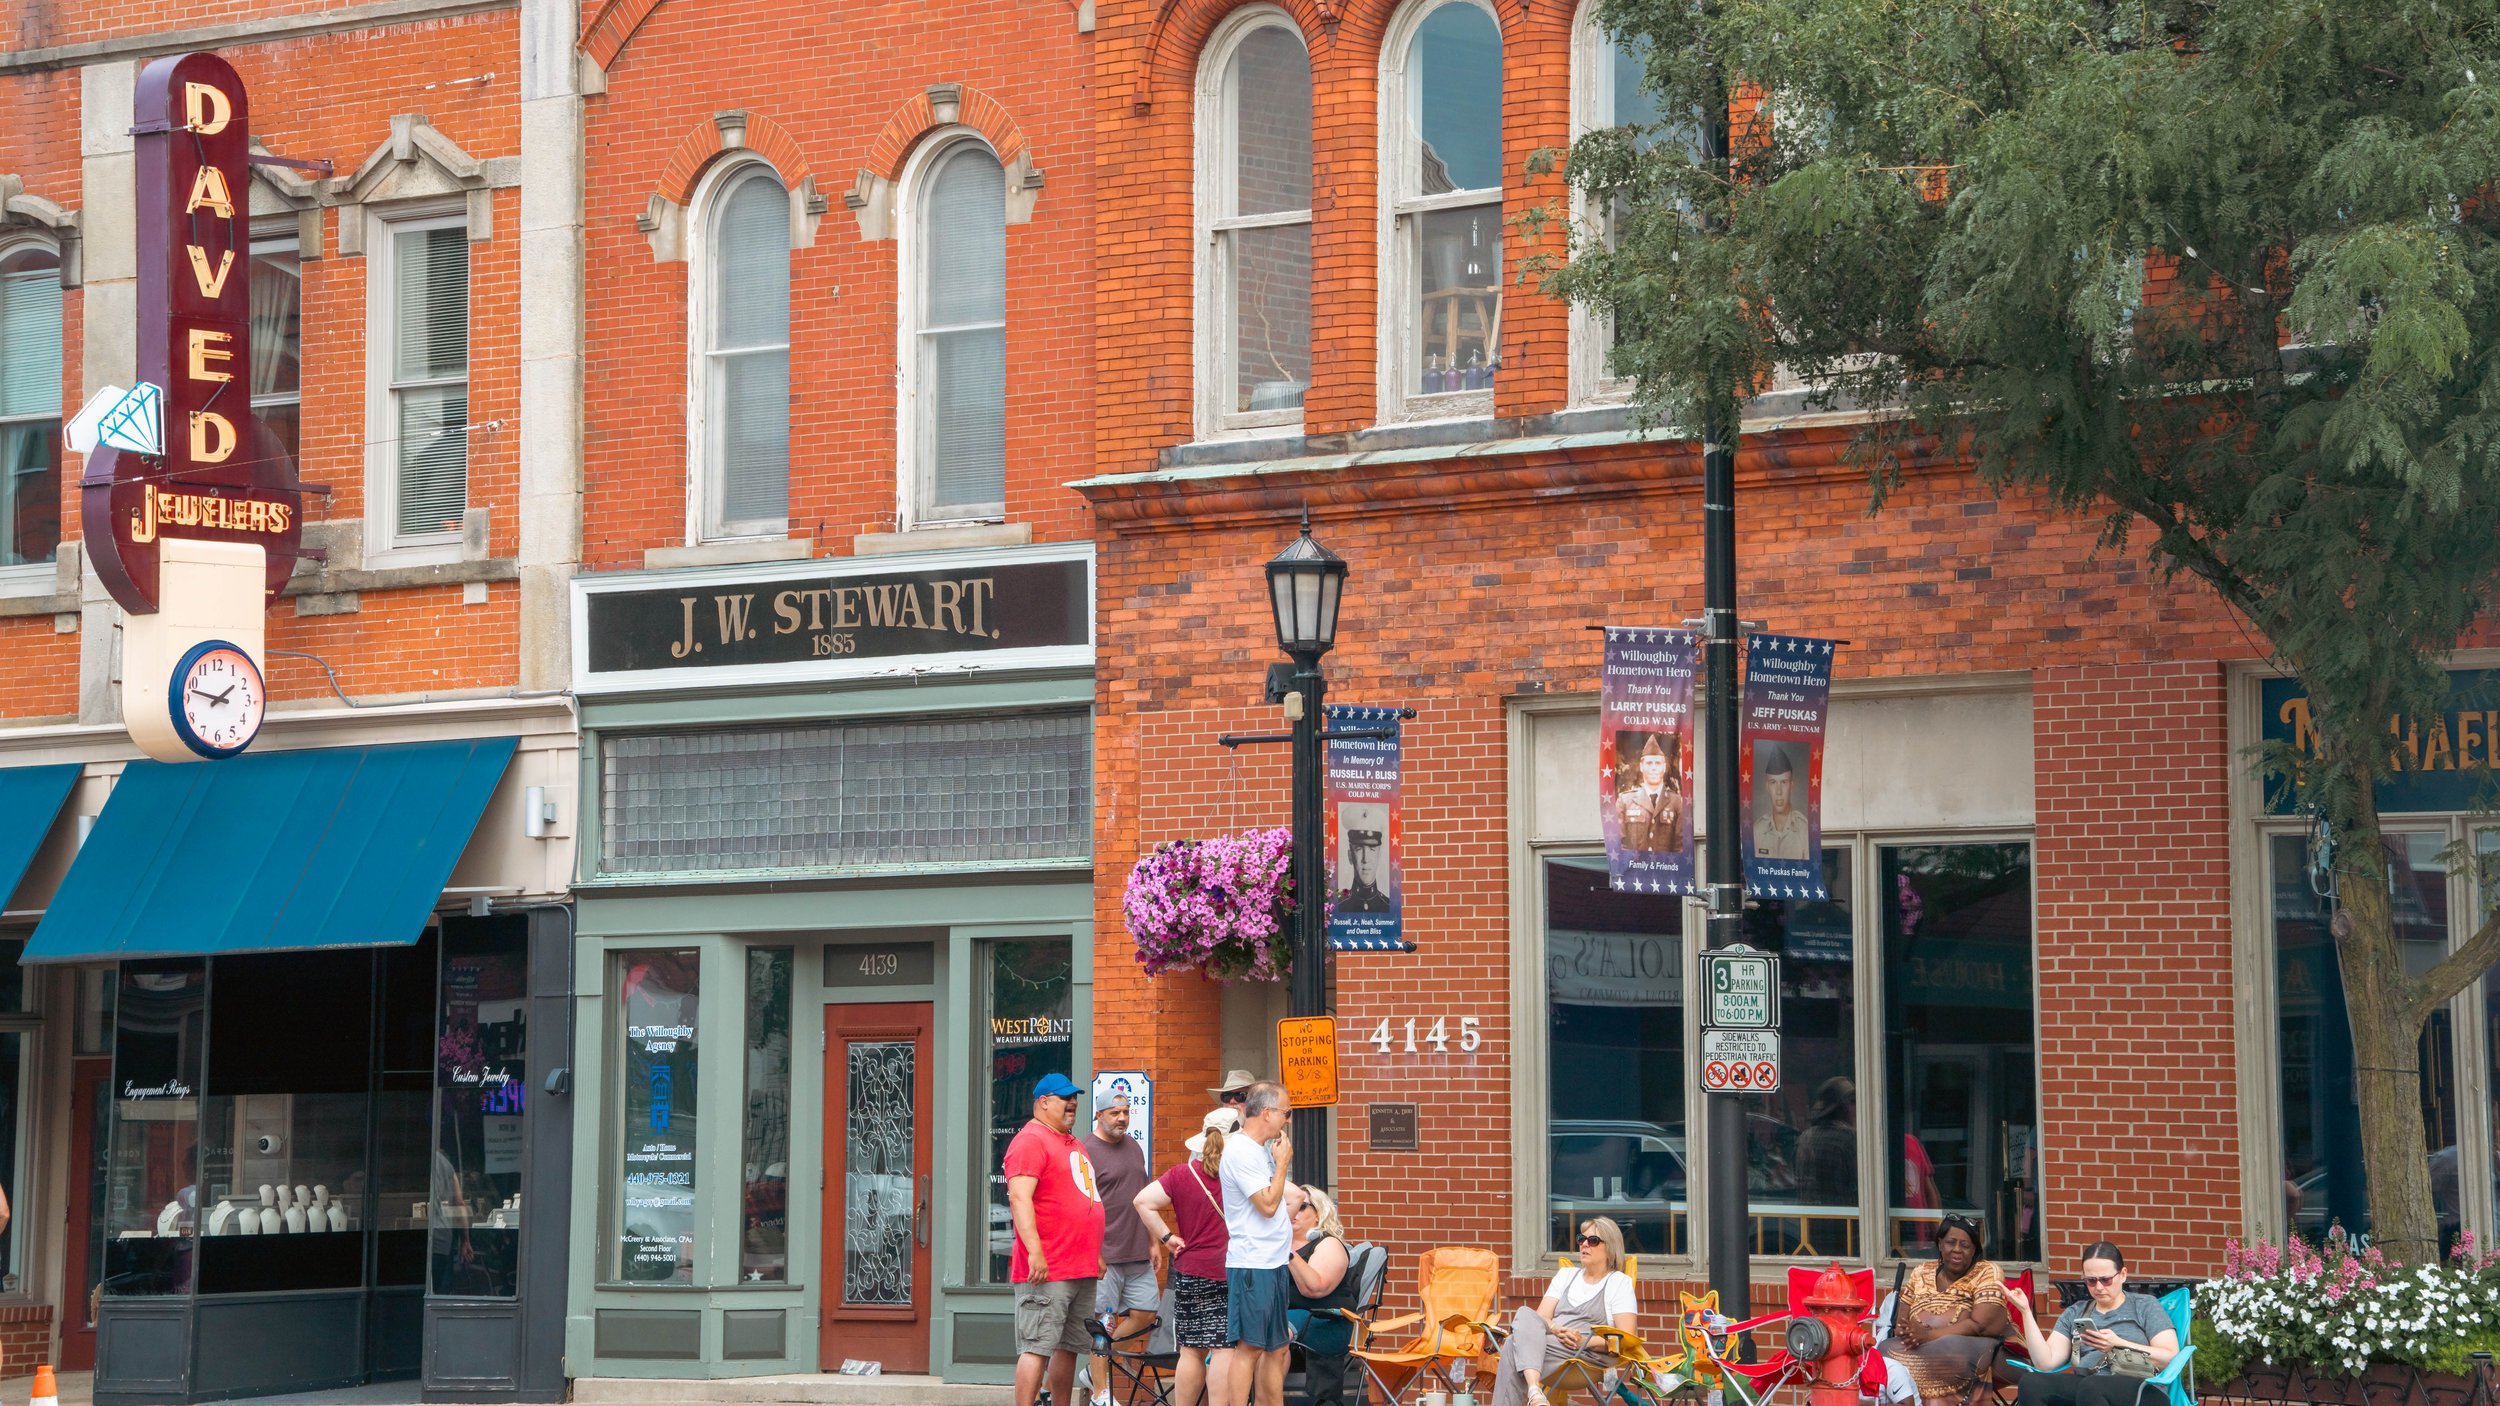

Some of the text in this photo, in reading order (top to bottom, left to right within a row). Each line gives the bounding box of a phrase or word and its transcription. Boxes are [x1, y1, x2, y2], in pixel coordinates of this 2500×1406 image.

[185, 81, 238, 463] DAVED
[131, 484, 292, 543] JEWELERS
[671, 597, 703, 659] J.
[714, 594, 757, 645] W.
[811, 632, 856, 657] 1885
[1620, 650, 1679, 665] Willoughby
[198, 663, 208, 676] 11
[212, 658, 224, 672] 12
[230, 663, 236, 677] 1
[1607, 664, 1692, 678] Hometown Hero
[1762, 657, 1817, 674] Willoughby
[241, 677, 247, 691] 2
[1749, 671, 1827, 687] Hometown Hero
[1628, 683, 1672, 695] Thank You
[244, 694, 252, 707] 3
[1767, 690, 1805, 702] Thank You
[1610, 701, 1687, 714] LARRY PUSKAS
[1752, 706, 1818, 721] JEFF PUSKAS
[239, 712, 246, 725] 4
[1623, 715, 1676, 727] COLD WAR
[200, 725, 207, 738] 7
[229, 725, 236, 739] 5
[1747, 721, 1761, 730] U.S.
[1761, 723, 1782, 731] ARMY
[1788, 724, 1820, 733] VIETNAM
[214, 729, 221, 743] 6
[1329, 738, 1397, 752] Hometown Hero
[1350, 755, 1376, 767] Memory
[1376, 756, 1385, 766] Of
[1329, 768, 1398, 781] RUSSELL P. BLISS
[1335, 781, 1347, 789] U.S.
[1347, 782, 1371, 790] MARINE
[1347, 790, 1380, 799] COLD WAR
[1628, 860, 1679, 871] Family & Friends
[1757, 866, 1811, 879] The Puskas Family
[1346, 927, 1382, 935] and Owen Bliss
[859, 953, 898, 976] 4139
[1741, 964, 1755, 976] HR
[1716, 967, 1729, 991] 3
[1731, 979, 1764, 991] PARKING
[1716, 1008, 1725, 1018] TO
[1725, 1008, 1746, 1020] 6:00
[628, 1024, 694, 1039] The Willoughby
[1369, 1015, 1481, 1053] 4145
[1721, 1032, 1760, 1042] SIDEWALKS
[996, 1034, 1070, 1044] WEALTH MANAGEMENT
[1282, 1034, 1332, 1048] STOPPING
[644, 1040, 677, 1054] Agency
[1302, 1047, 1313, 1055] OR
[1715, 1042, 1767, 1052] RESTRICTED TO
[1288, 1055, 1329, 1068] PARKING
[1705, 1052, 1776, 1062] PEDESTRIAN TRAFFIC
[452, 1065, 511, 1088] Custom Jewelry
[124, 1078, 191, 1102] Engagement Rings
[1133, 1130, 1144, 1141] St.
[626, 1171, 690, 1185] 440-975-0321
[620, 1235, 644, 1243] McCreery
[678, 1234, 693, 1243] CPAs
[639, 1244, 672, 1252] Second Floor
[634, 1254, 677, 1263] (440) 946-5001
